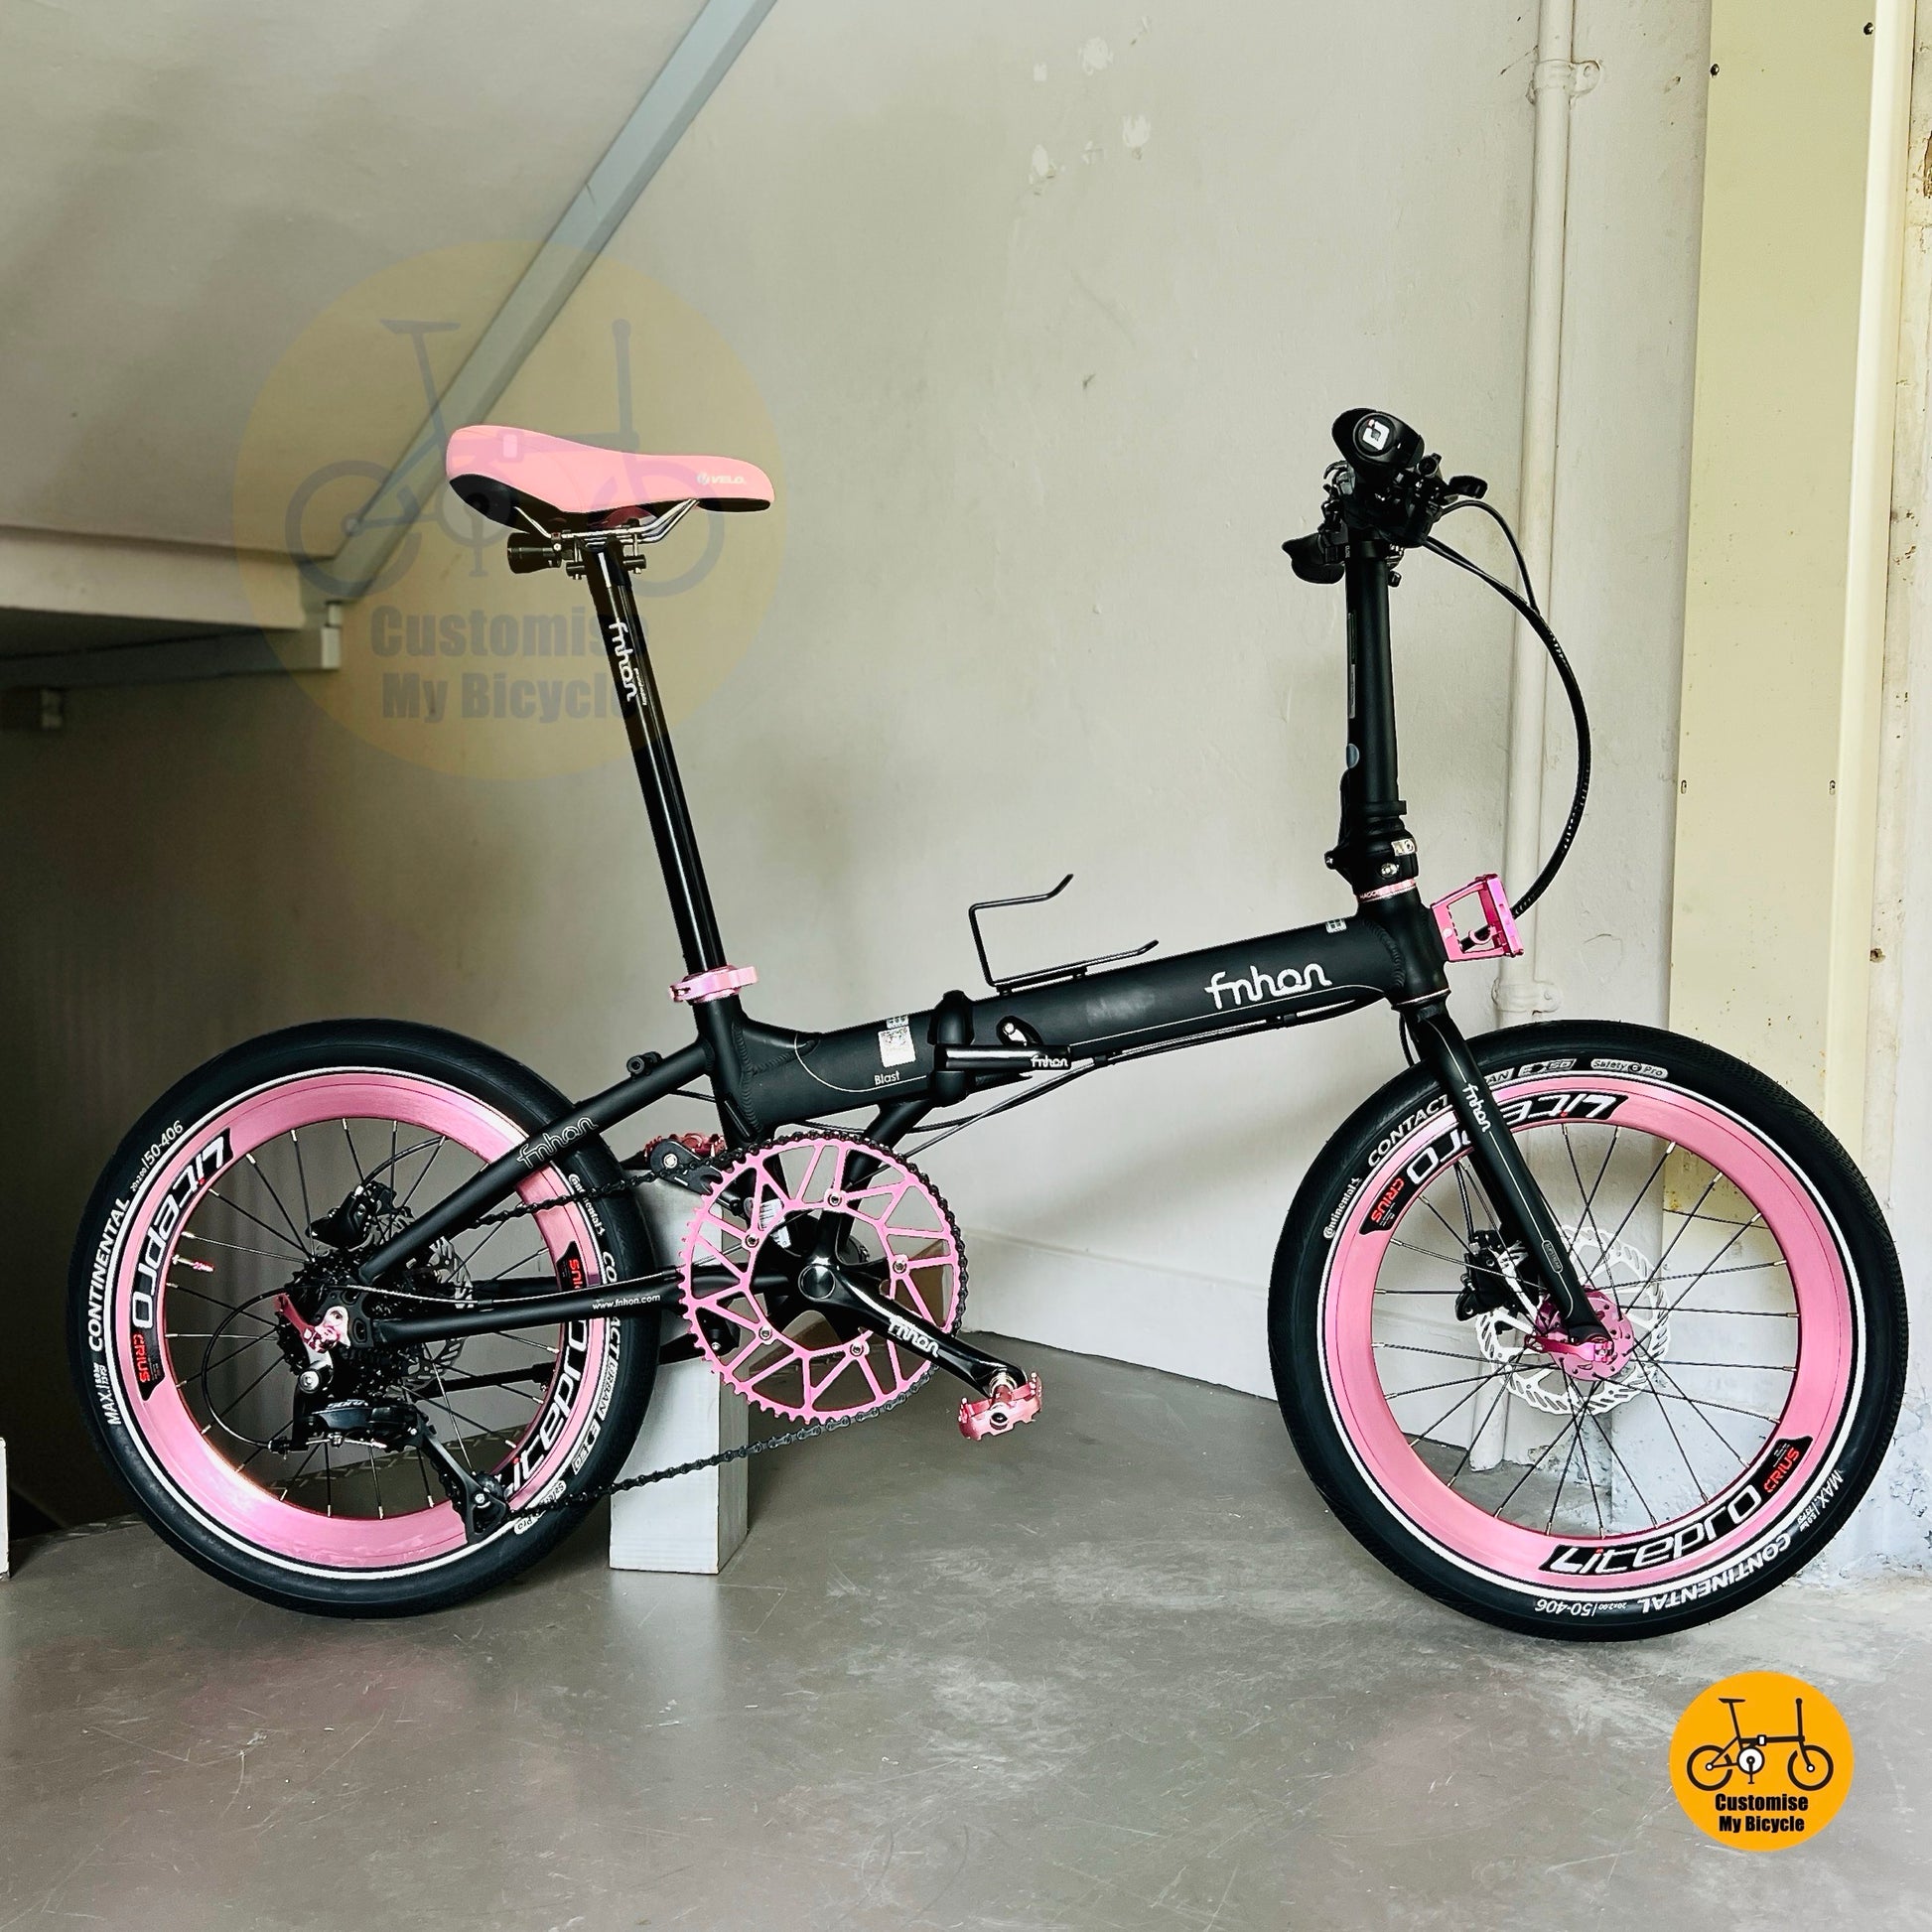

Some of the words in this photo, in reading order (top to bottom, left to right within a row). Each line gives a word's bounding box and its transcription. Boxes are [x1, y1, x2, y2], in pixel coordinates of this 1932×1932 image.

[609, 620, 637, 703] fnhon
[1204, 962, 1332, 1011] fnhon
[874, 1069, 900, 1086] Blast
[1029, 1054, 1069, 1068] fnhon
[1592, 1059, 1627, 1073] Safety
[1644, 1066, 1664, 1077] Pro
[1462, 1082, 1492, 1133] fnhon
[516, 1115, 600, 1170] fnhon
[1322, 1181, 1360, 1240] Continental
[1370, 1177, 1405, 1223] CRIUS
[87, 1197, 130, 1352] CONTINENTAL
[592, 1295, 661, 1311] www.fnhon.com
[132, 1332, 151, 1384] CRIUS
[597, 1358, 619, 1419] URBAN
[1763, 1447, 1800, 1493] CRIUS
[1549, 1483, 1762, 1576] Litepro
[1636, 1532, 1791, 1614] CONTINENTAL
